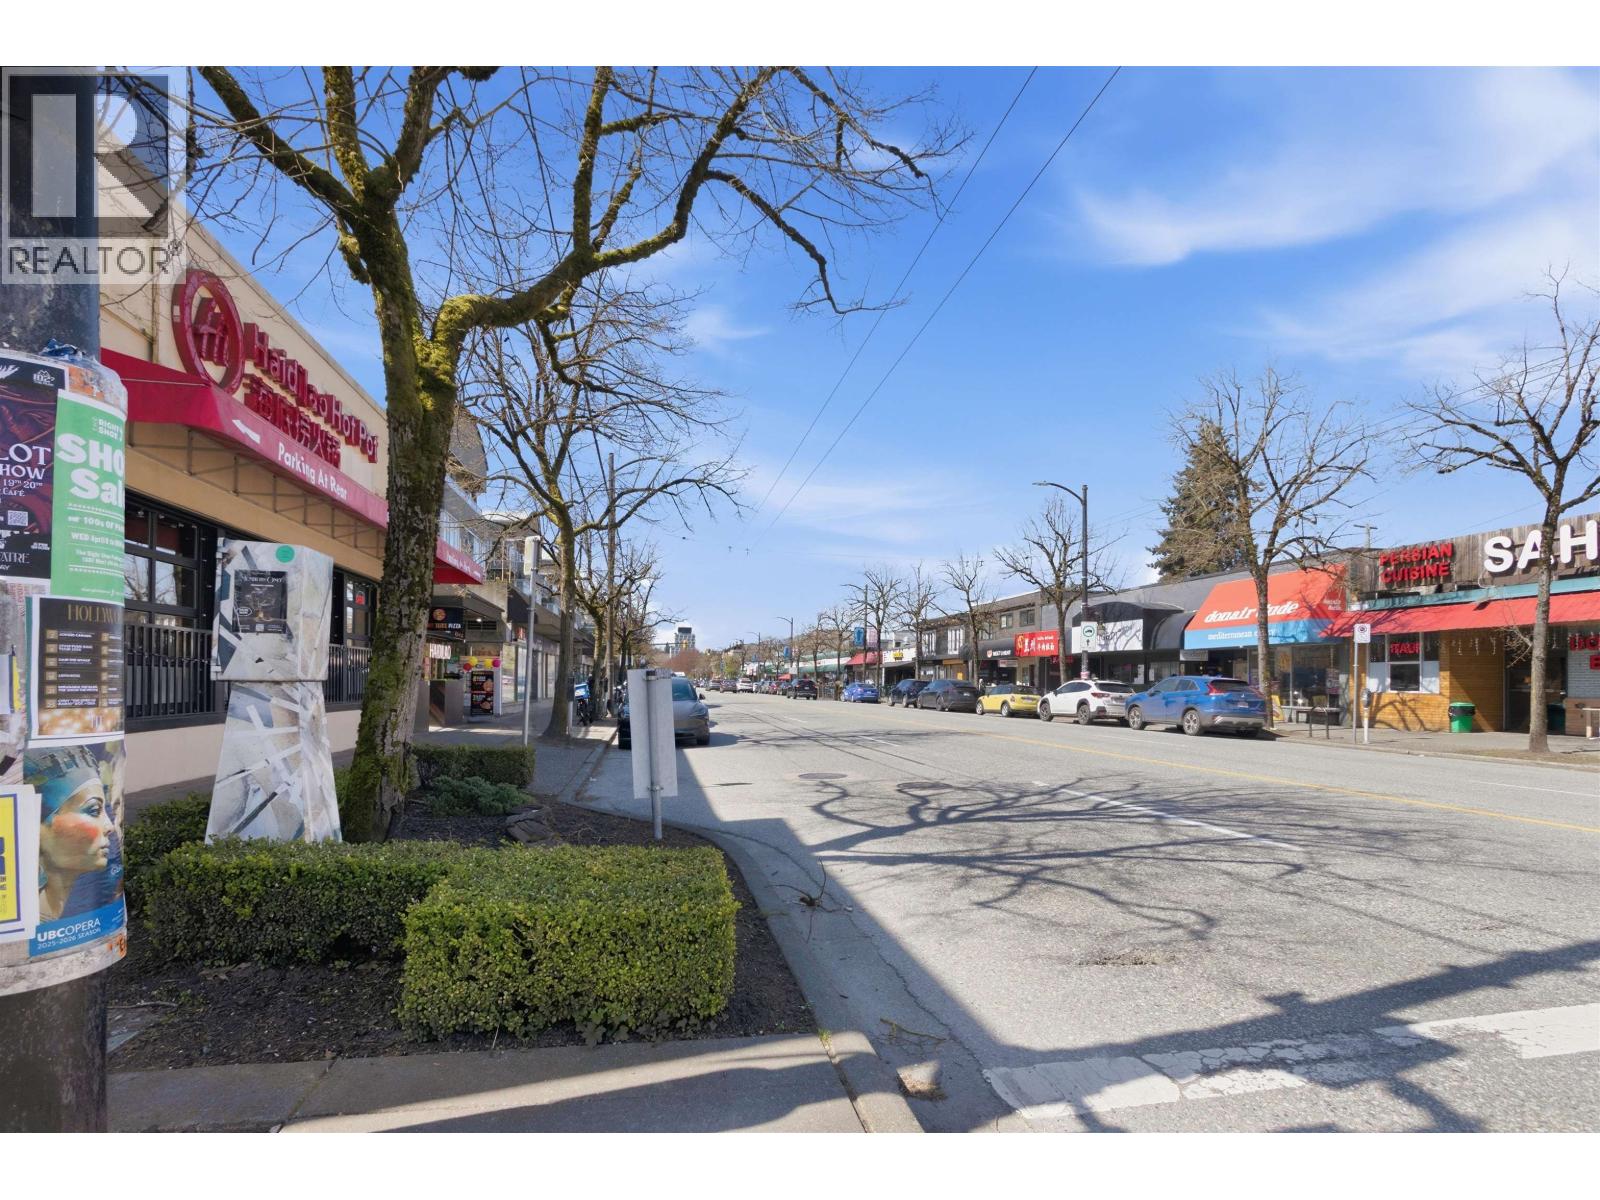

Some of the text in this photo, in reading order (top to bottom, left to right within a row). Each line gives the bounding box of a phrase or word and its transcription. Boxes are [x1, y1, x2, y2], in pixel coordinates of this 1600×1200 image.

[324, 394, 356, 446] Hot
[359, 418, 379, 464] Pot
[278, 442, 347, 501] Parking At Rear
[1378, 543, 1453, 566] PERSIAN
[1381, 560, 1451, 584] CUISINE
[1204, 607, 1257, 623] donair
[37, 918, 101, 942] UBCOPERA
